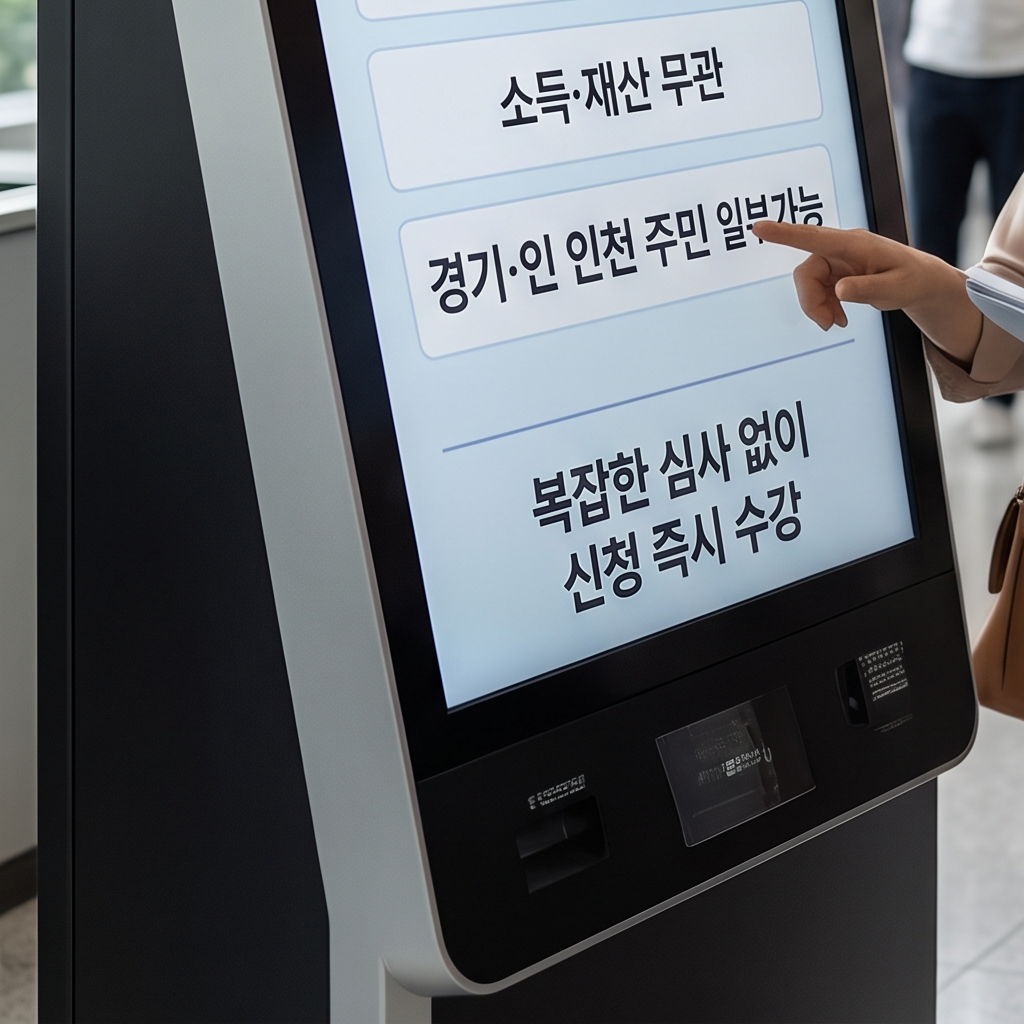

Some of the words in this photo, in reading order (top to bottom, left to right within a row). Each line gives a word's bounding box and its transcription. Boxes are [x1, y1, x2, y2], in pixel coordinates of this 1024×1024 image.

[660, 46, 725, 107] 무관
[566, 217, 638, 286] 인천
[644, 203, 711, 268] 주민
[532, 447, 650, 534] 복잡한
[659, 423, 732, 500] 심사
[738, 400, 810, 475] 없이
[563, 531, 643, 614] 신청
[652, 505, 727, 578] 즉시
[735, 480, 802, 554] 수강
